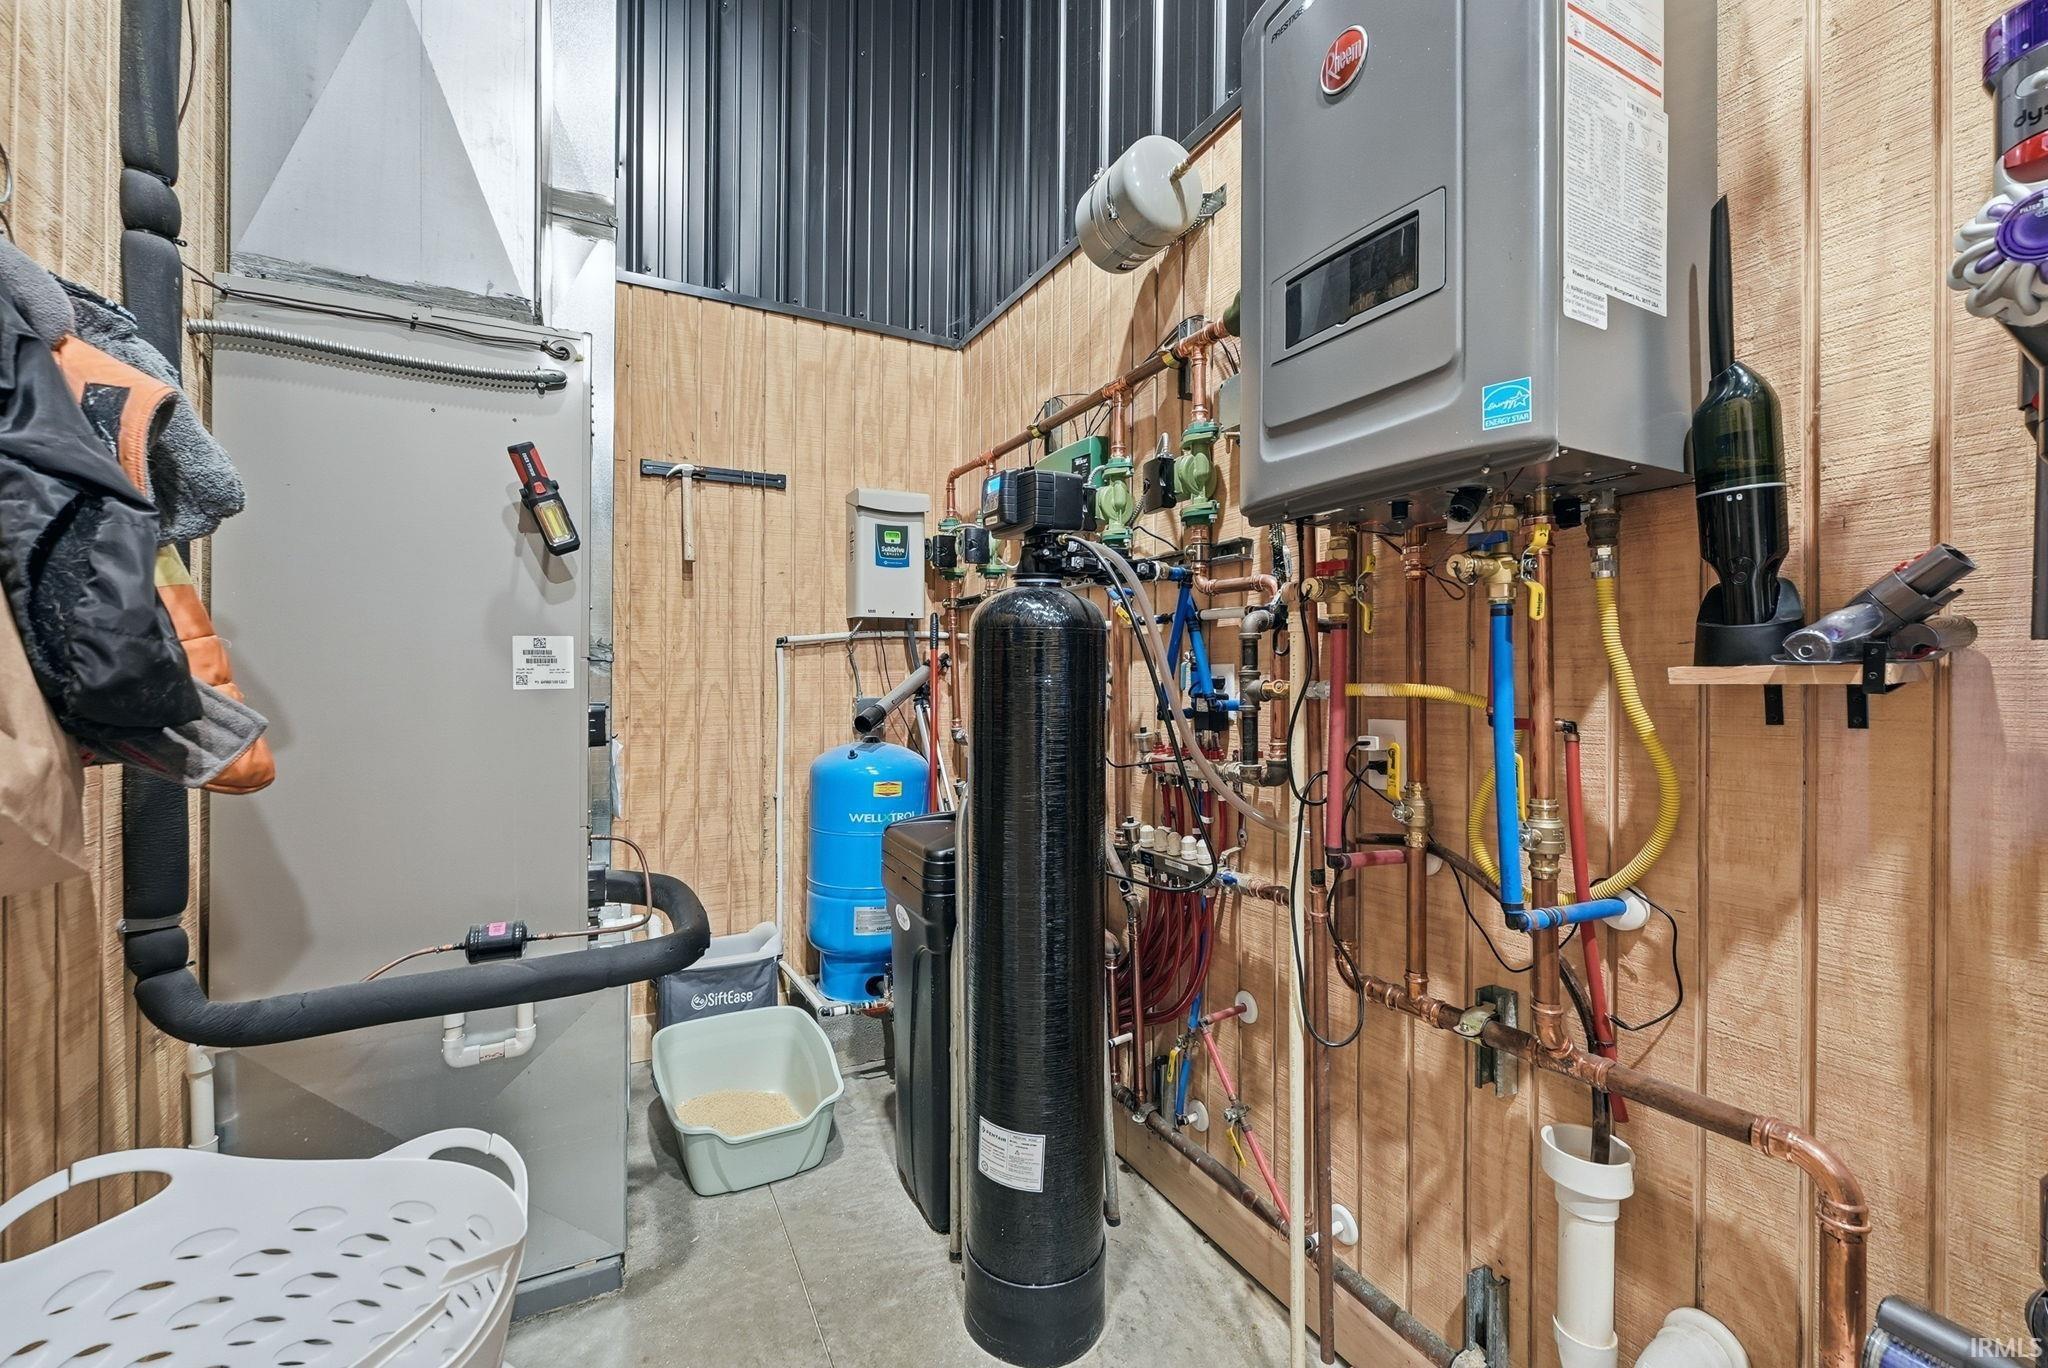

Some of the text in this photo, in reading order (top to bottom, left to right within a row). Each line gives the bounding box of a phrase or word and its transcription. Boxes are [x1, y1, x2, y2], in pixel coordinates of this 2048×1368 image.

[1325, 40, 1362, 87] Rheem
[1485, 413, 1529, 427] ENERGY STAR
[881, 545, 905, 554] SubDrive
[708, 990, 754, 1006] SiftEase
